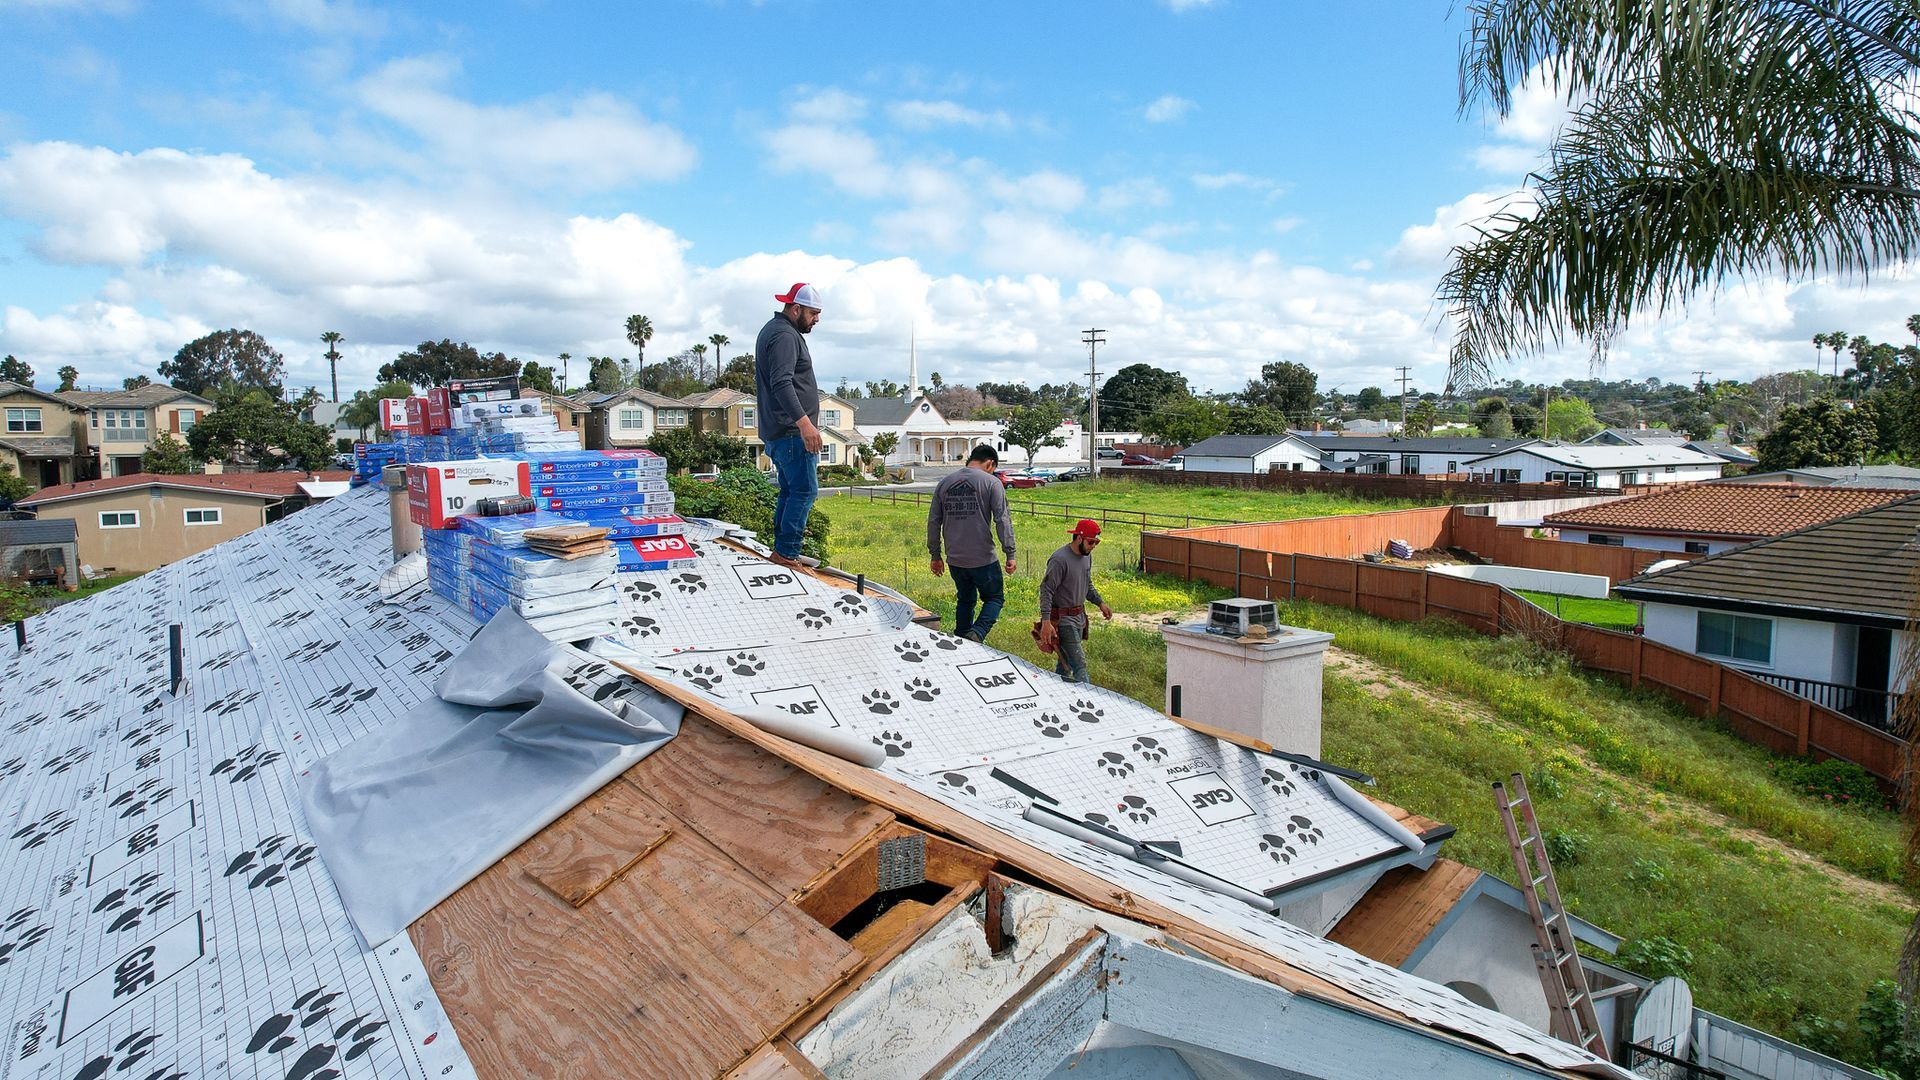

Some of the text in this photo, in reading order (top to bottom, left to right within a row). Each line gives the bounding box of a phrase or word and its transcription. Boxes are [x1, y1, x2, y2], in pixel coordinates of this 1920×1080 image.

[498, 404, 512, 414] bc
[640, 538, 684, 552] GAF
[748, 574, 792, 587] GAF
[975, 672, 1017, 688] GAF
[990, 702, 1037, 714] TigerPaw
[1166, 760, 1212, 775] TigerPaw
[1192, 788, 1234, 809] GAF
[127, 824, 159, 857] GAF
[113, 946, 156, 999] GAF
[19, 1000, 53, 1060] TigerPaw
